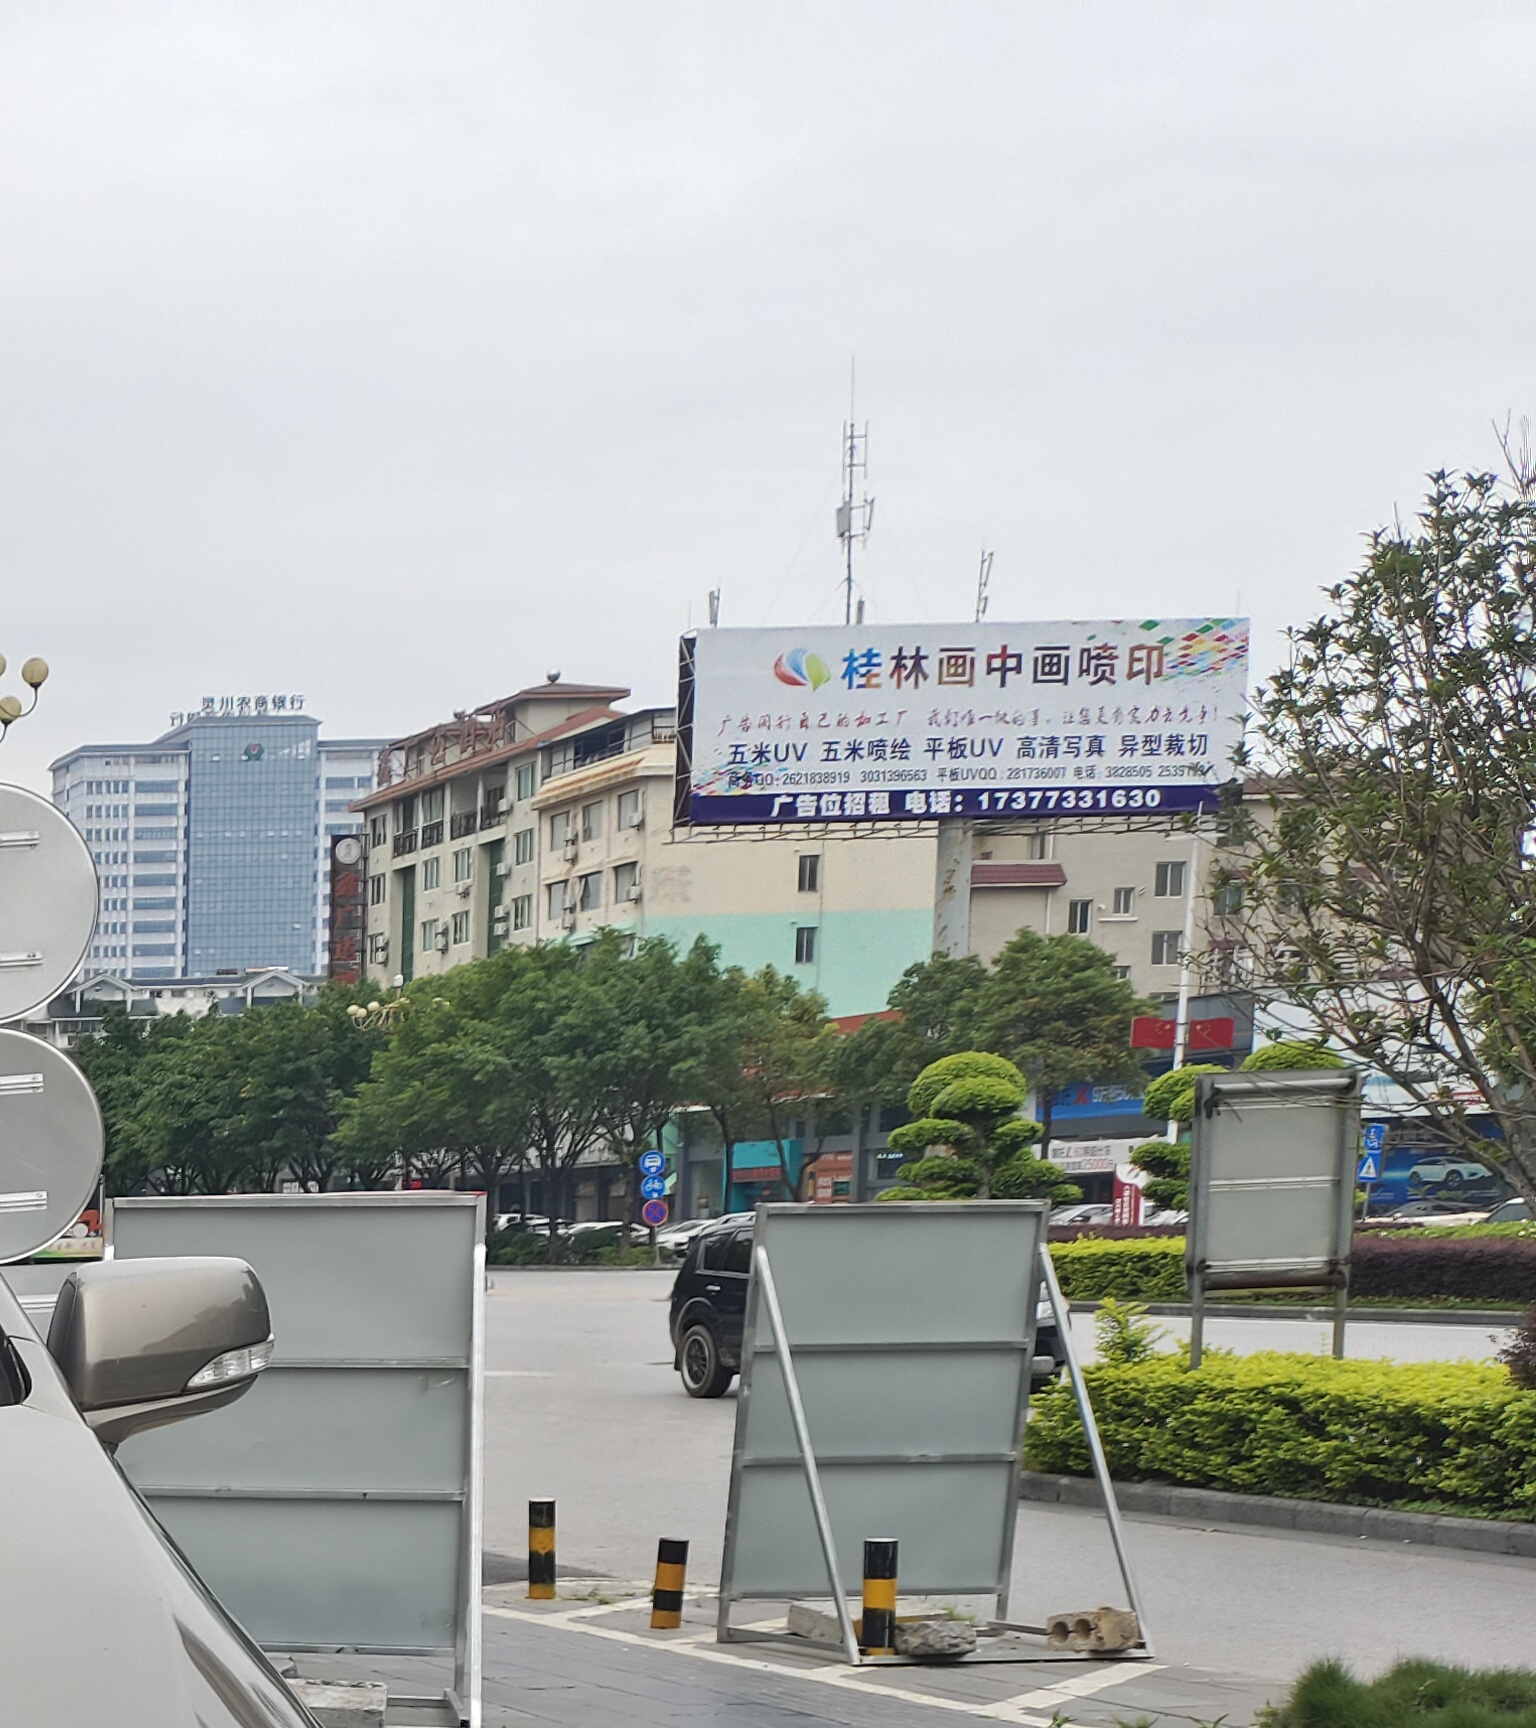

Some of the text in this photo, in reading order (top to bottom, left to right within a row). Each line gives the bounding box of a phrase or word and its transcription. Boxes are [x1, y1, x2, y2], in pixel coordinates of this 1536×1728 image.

[841, 643, 1164, 690] 桂林画中画喷印
[728, 732, 1209, 765] 五米UV 五米喷绘 平板UV 高清写真 异型裁切
[771, 793, 891, 818] 广告位招租
